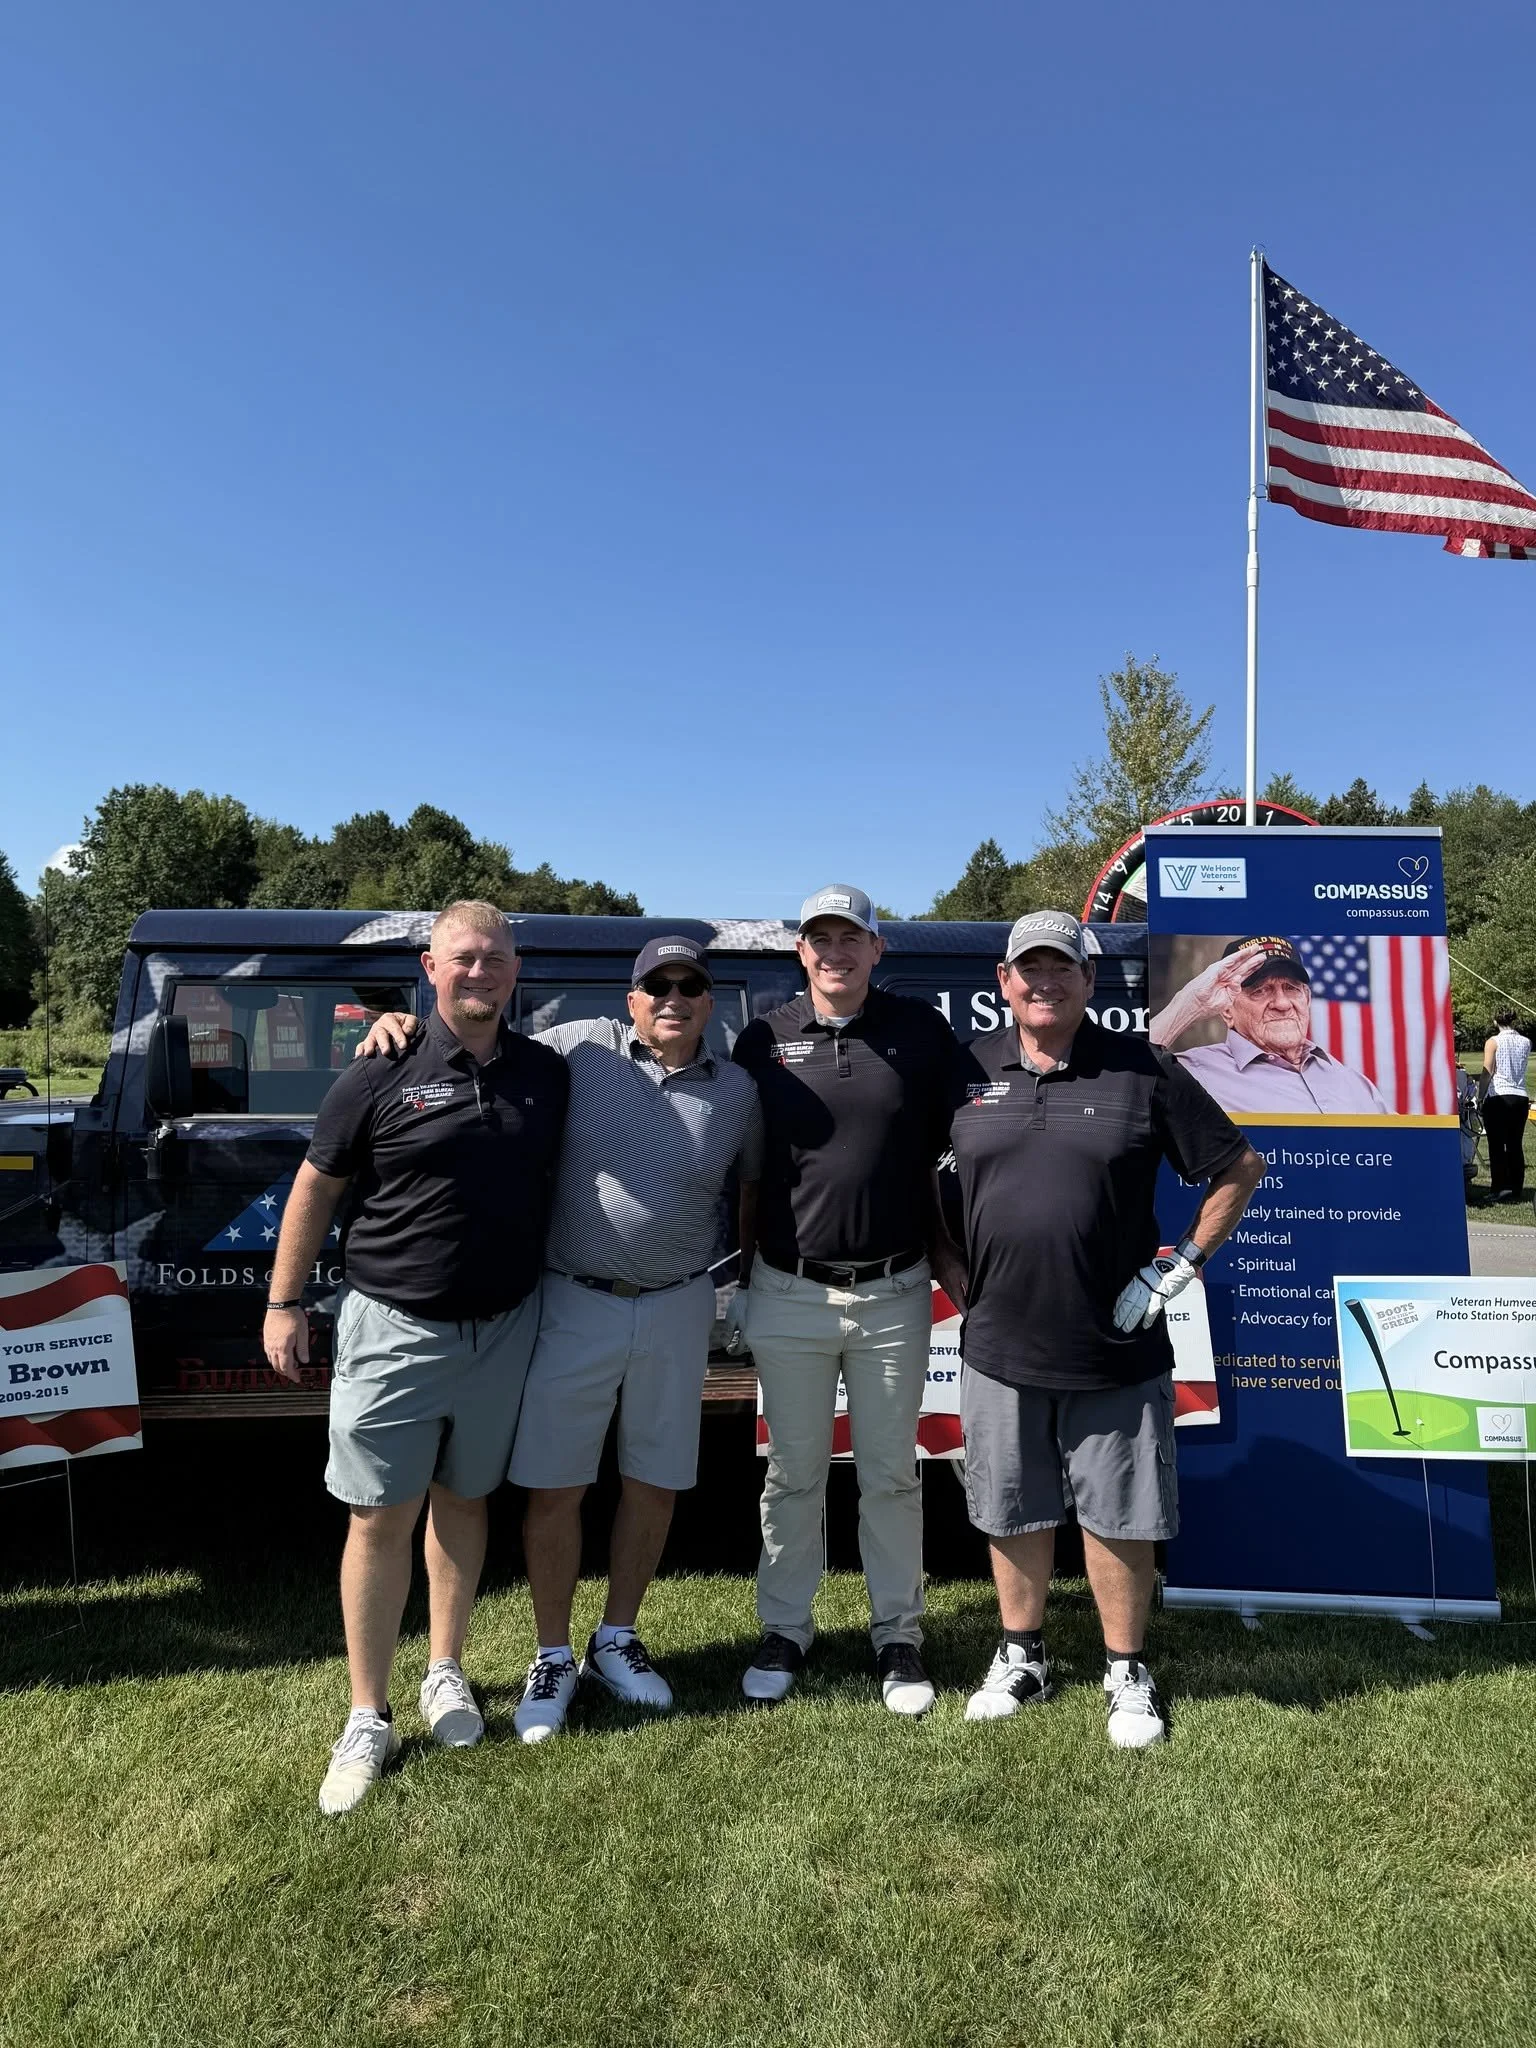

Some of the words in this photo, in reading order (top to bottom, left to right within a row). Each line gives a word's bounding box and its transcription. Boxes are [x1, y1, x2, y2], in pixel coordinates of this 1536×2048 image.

[1216, 806, 1241, 823] 20
[1093, 891, 1113, 912] 14
[1346, 909, 1430, 919] compassus.com
[1015, 917, 1078, 939] Titleist
[1238, 936, 1267, 950] WORLD
[1269, 936, 1287, 947] WAR
[1282, 1148, 1350, 1169] hospice
[1355, 1152, 1393, 1167] care
[1240, 1205, 1271, 1222] uely
[1274, 1206, 1325, 1220] trained
[1328, 1208, 1344, 1220] to
[1347, 1208, 1402, 1223] provide
[1236, 1231, 1291, 1245] Medical
[1237, 1258, 1296, 1273] Spiritual
[156, 1263, 255, 1286] FOLDS
[1239, 1284, 1311, 1299] Emotional
[1450, 1296, 1492, 1307] Veteran
[1494, 1297, 1536, 1308] Humvee
[1376, 1302, 1415, 1320] BOOTS
[1436, 1310, 1469, 1320] Photo
[1470, 1310, 1509, 1321] Station
[1240, 1311, 1309, 1329] Advocacy
[1312, 1312, 1332, 1326] for
[1381, 1314, 1419, 1330] GREEN
[2, 1342, 46, 1356] YOUR
[49, 1333, 113, 1350] SERVICE
[1280, 1355, 1296, 1369] to
[8, 1358, 111, 1385] Brown
[1231, 1373, 1267, 1388] have
[1271, 1376, 1321, 1390] served
[0, 1385, 69, 1403] 2009-2015
